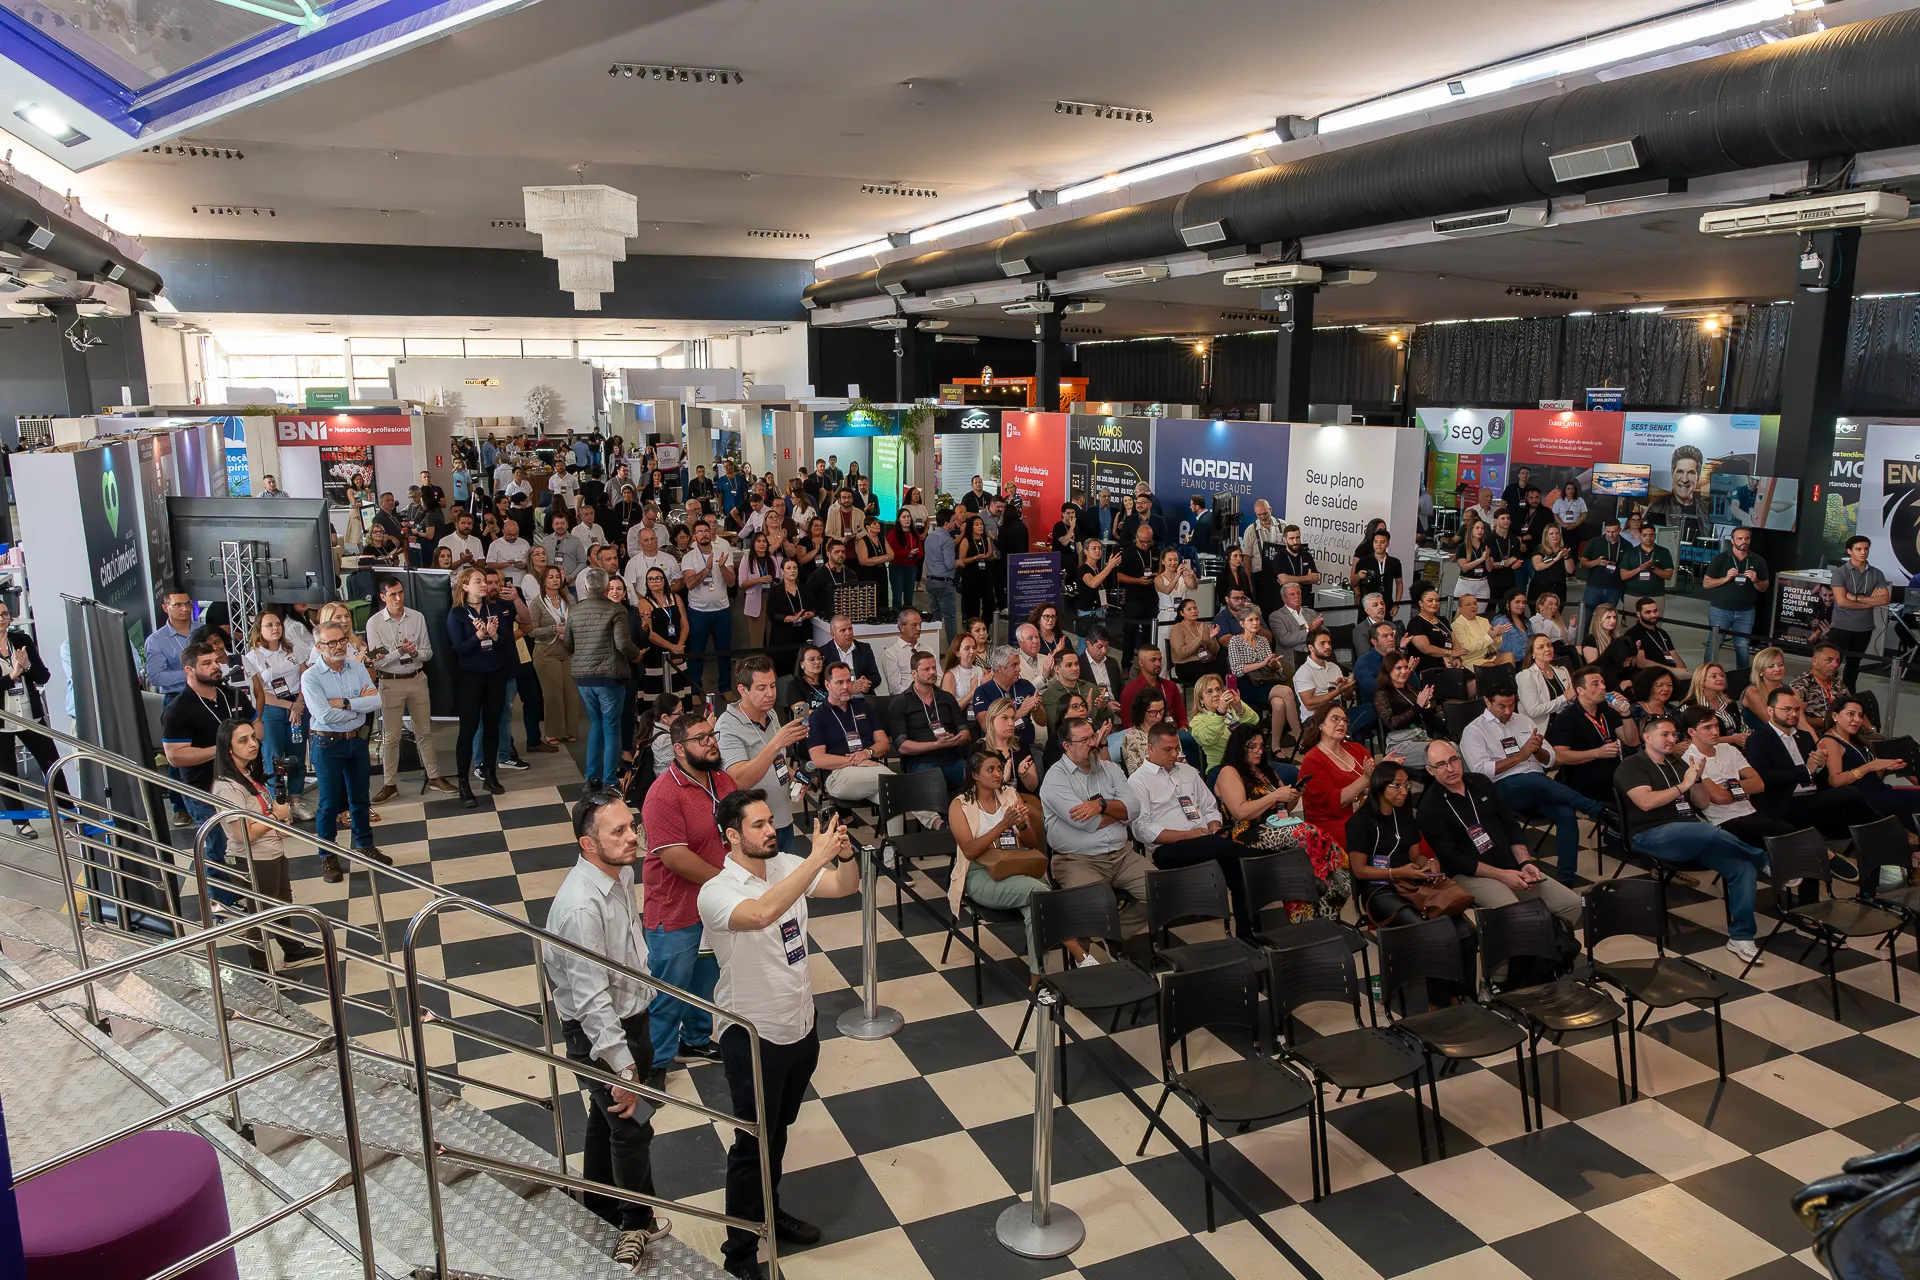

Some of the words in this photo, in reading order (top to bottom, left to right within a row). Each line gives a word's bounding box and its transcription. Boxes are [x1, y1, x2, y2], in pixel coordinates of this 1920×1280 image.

[278, 421, 328, 440] BNI
[334, 426, 372, 434] Networking
[372, 426, 411, 434] profissional
[1098, 425, 1122, 438] VAMOS
[1080, 436, 1110, 452] INVESTIR
[1112, 439, 1143, 454] JUNTOS
[226, 454, 248, 463] teçã
[226, 464, 248, 474] pírit
[1018, 465, 1030, 473] saúde
[1030, 466, 1049, 476] tributária
[1181, 458, 1253, 481] NORDEN
[1888, 464, 1920, 484] EN
[1181, 478, 1207, 490] PLANO
[1210, 482, 1220, 491] DE
[1223, 482, 1252, 494] SAÚDE
[1306, 469, 1327, 485] Seu
[1330, 472, 1364, 489] plano
[1305, 491, 1320, 506] de
[1321, 494, 1358, 510] saúde
[1303, 515, 1368, 535] empresaria
[1311, 547, 1345, 566] anhou
[1784, 586, 1811, 595] PROTEJA
[1782, 604, 1802, 612] TOQUE
